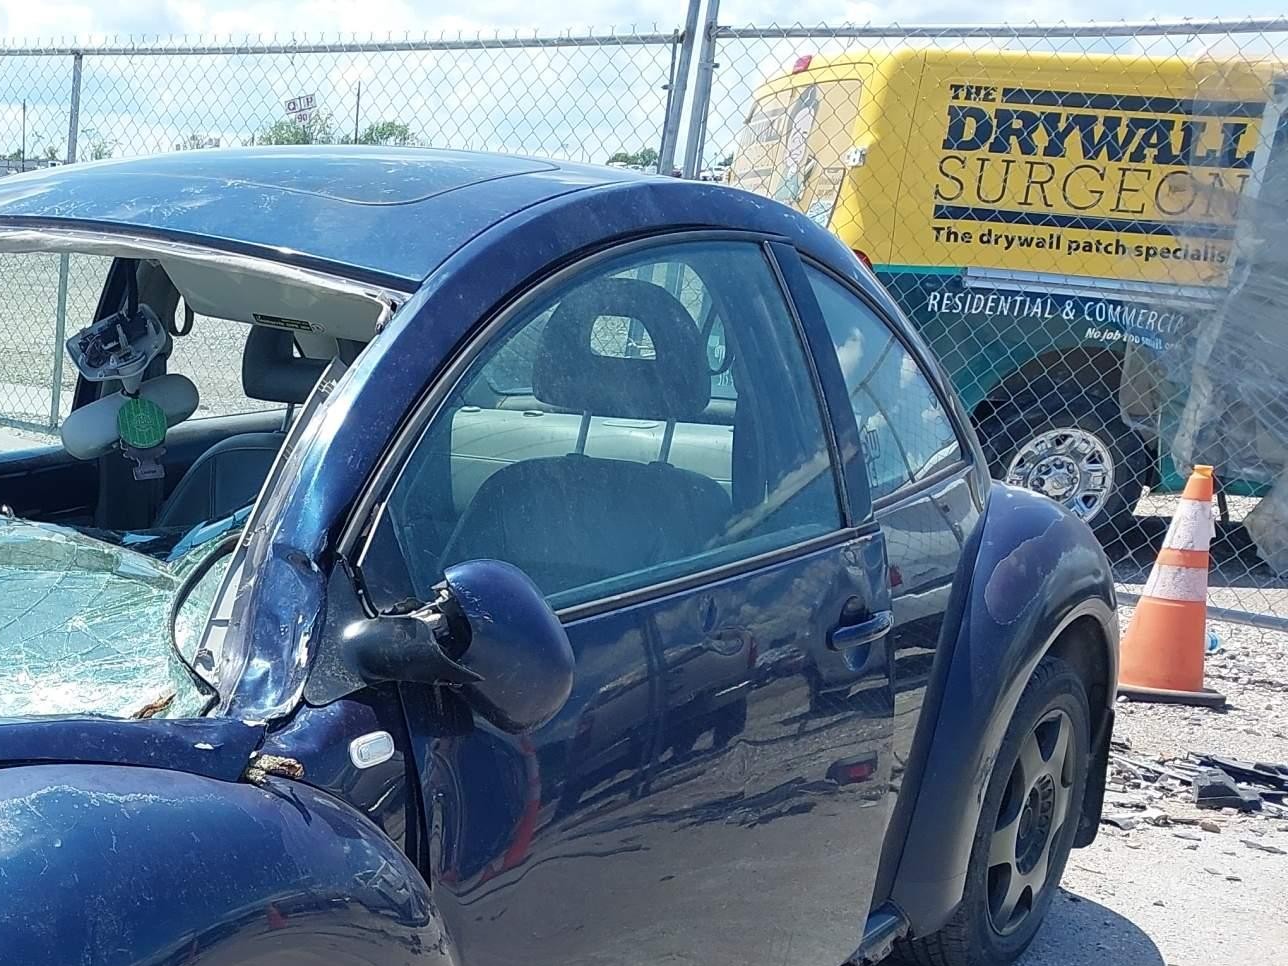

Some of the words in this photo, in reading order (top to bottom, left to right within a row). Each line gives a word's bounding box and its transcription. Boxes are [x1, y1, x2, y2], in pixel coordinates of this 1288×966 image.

[949, 83, 998, 103] THE
[942, 104, 1255, 169] DRYWALL
[934, 155, 1249, 219] SURGEON
[932, 226, 974, 246] The
[978, 229, 1062, 252] drywall
[1067, 237, 1127, 256] patch
[1134, 243, 1228, 265] specialis
[927, 292, 1055, 320] RESIDENTIAL
[1062, 300, 1076, 320] &
[1084, 301, 1185, 333] COMMERCIA
[1085, 327, 1101, 339] No
[1100, 329, 1122, 342] job
